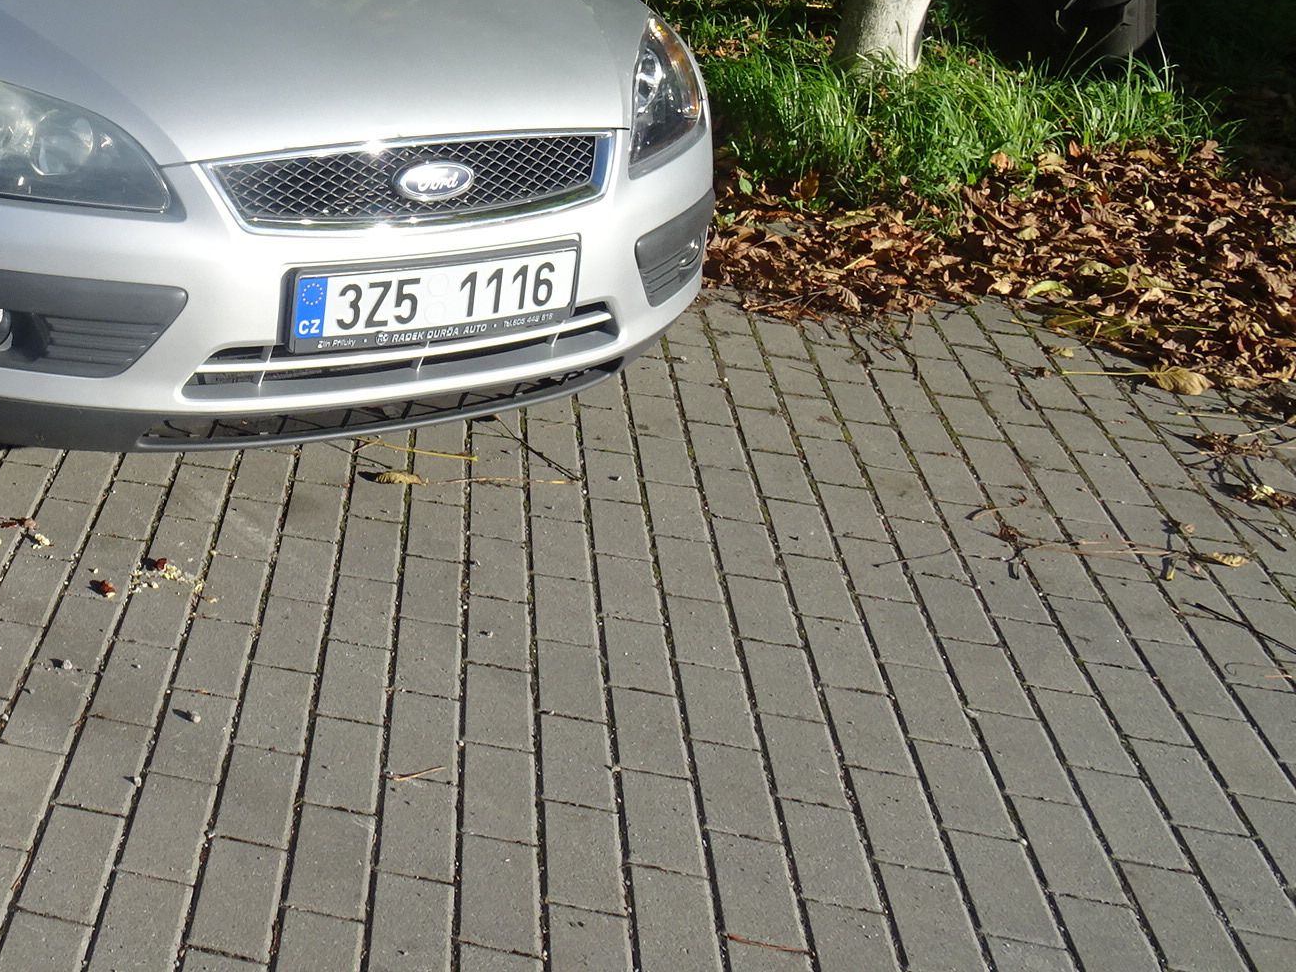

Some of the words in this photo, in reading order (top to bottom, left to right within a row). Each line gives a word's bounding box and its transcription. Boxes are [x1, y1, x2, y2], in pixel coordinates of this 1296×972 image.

[336, 277, 421, 330] 3Z5
[460, 261, 556, 318] 1116
[298, 318, 321, 335] CZ
[463, 323, 487, 335] AUTO
